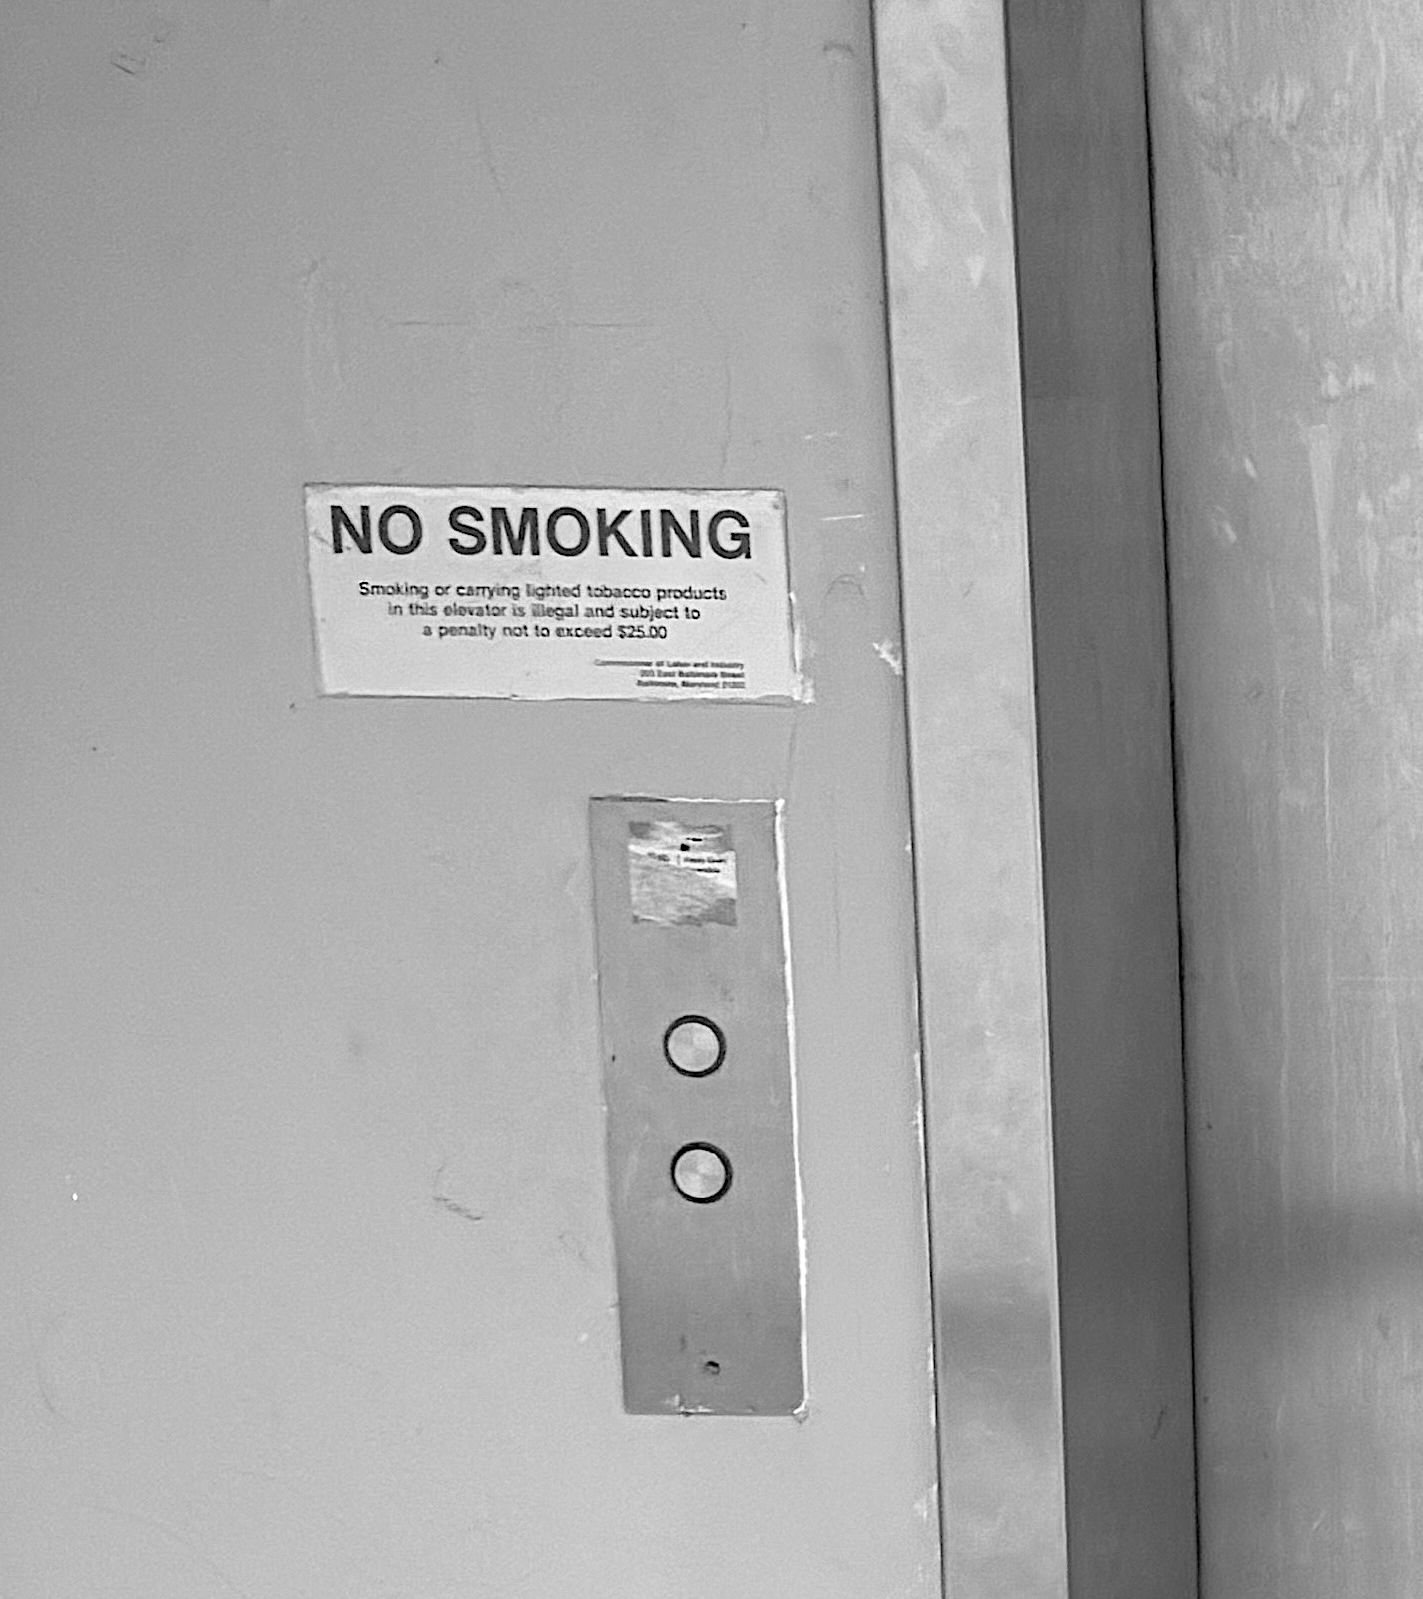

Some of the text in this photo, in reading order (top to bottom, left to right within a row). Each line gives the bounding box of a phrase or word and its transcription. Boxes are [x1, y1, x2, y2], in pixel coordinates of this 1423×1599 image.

[330, 504, 753, 560] NO SMOKING
[358, 581, 728, 602] Smoking or carrying lighted tobacco products
[387, 602, 701, 622] in this elevator is illegal and subject to
[422, 623, 668, 641] a penalty not to exceed $25.00
